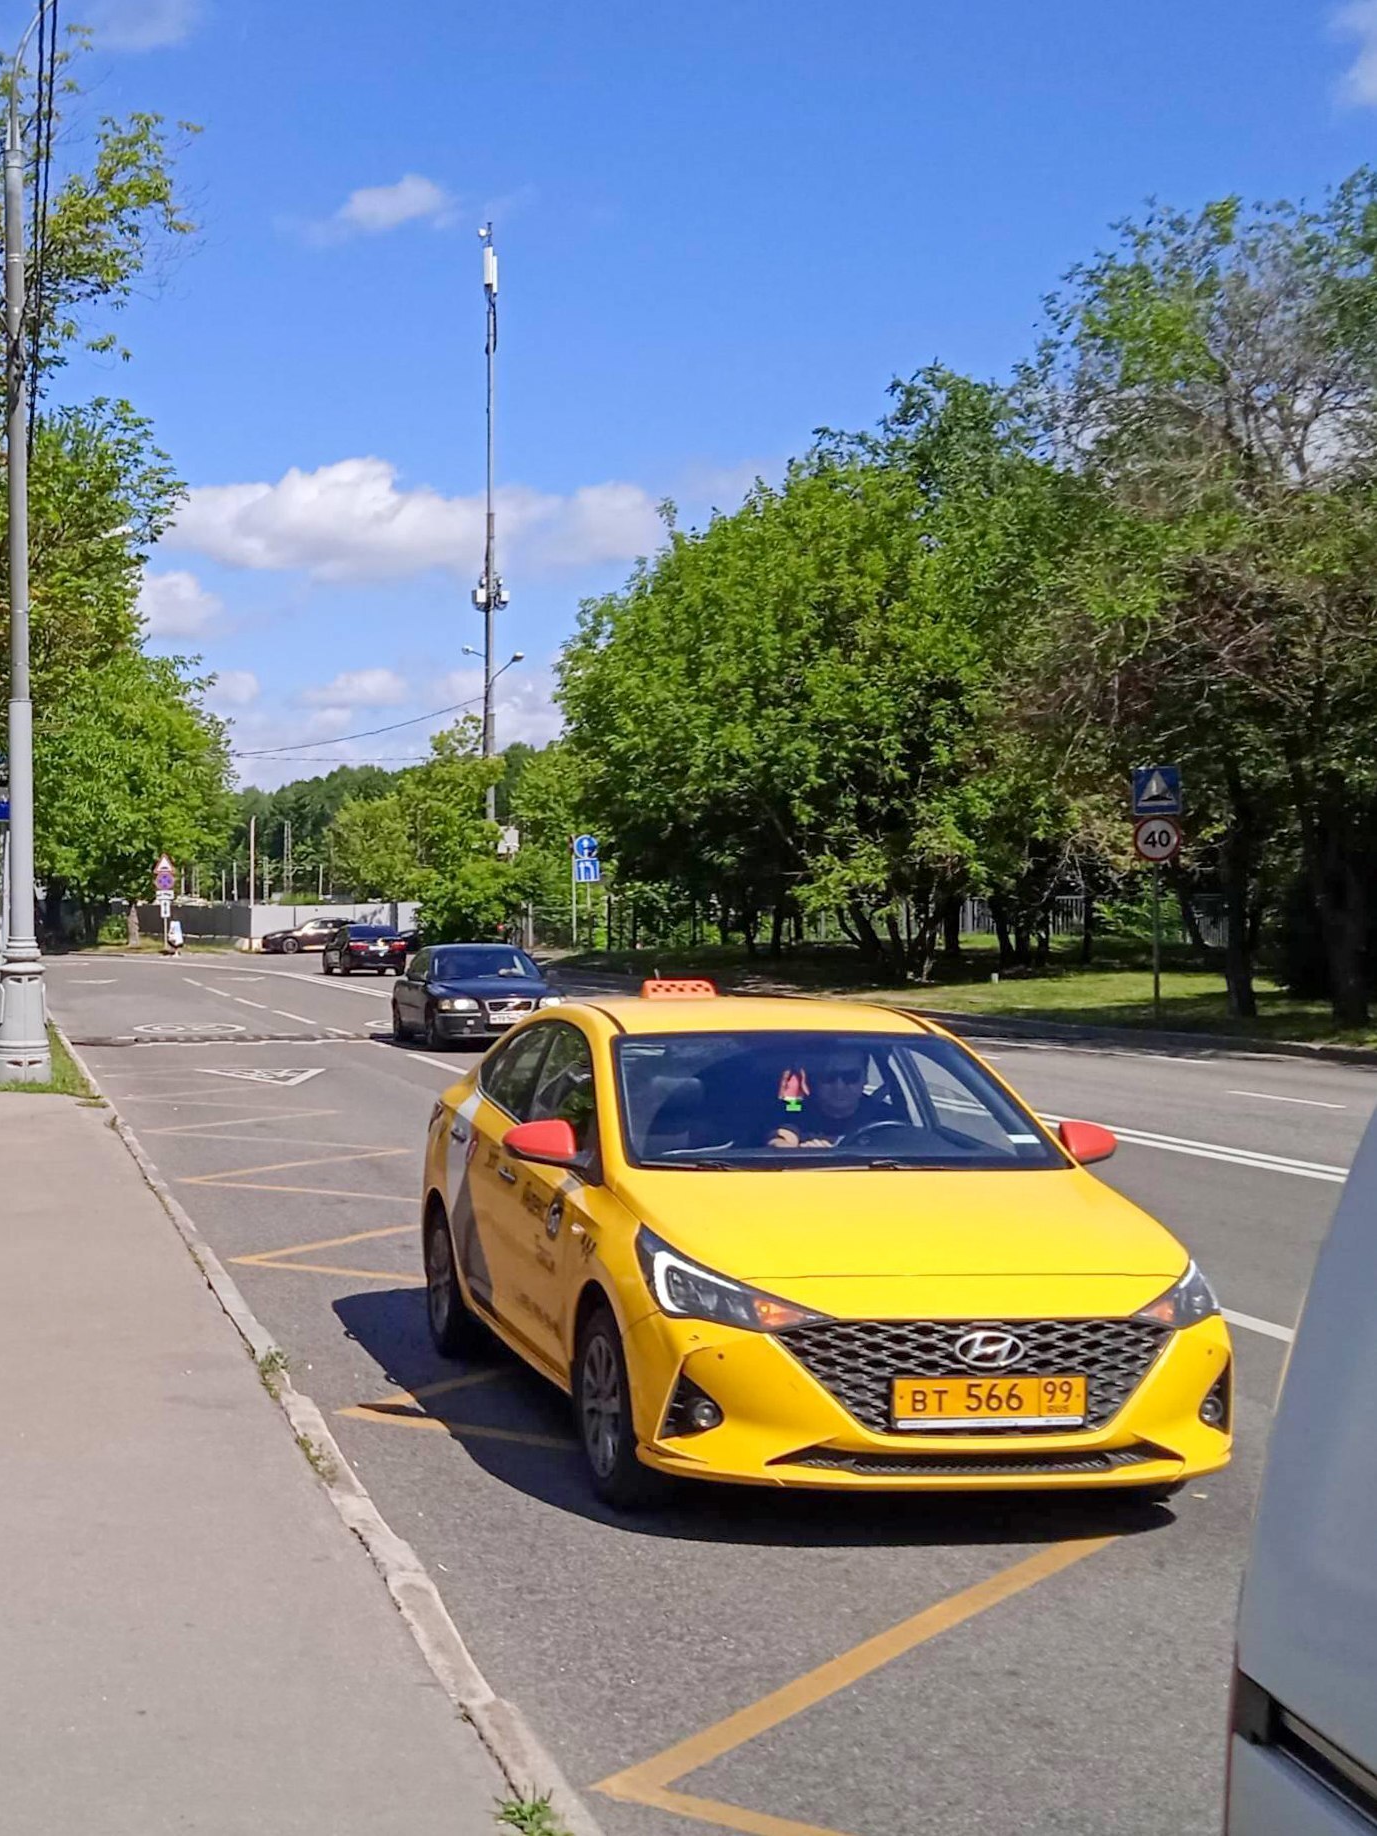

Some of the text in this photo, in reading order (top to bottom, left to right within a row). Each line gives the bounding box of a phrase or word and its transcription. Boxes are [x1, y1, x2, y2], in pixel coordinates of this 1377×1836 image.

[1143, 830, 1171, 848] 40
[965, 1383, 1023, 1412] 566
[1043, 1380, 1073, 1403] 99
[1047, 1405, 1069, 1414] RUS
